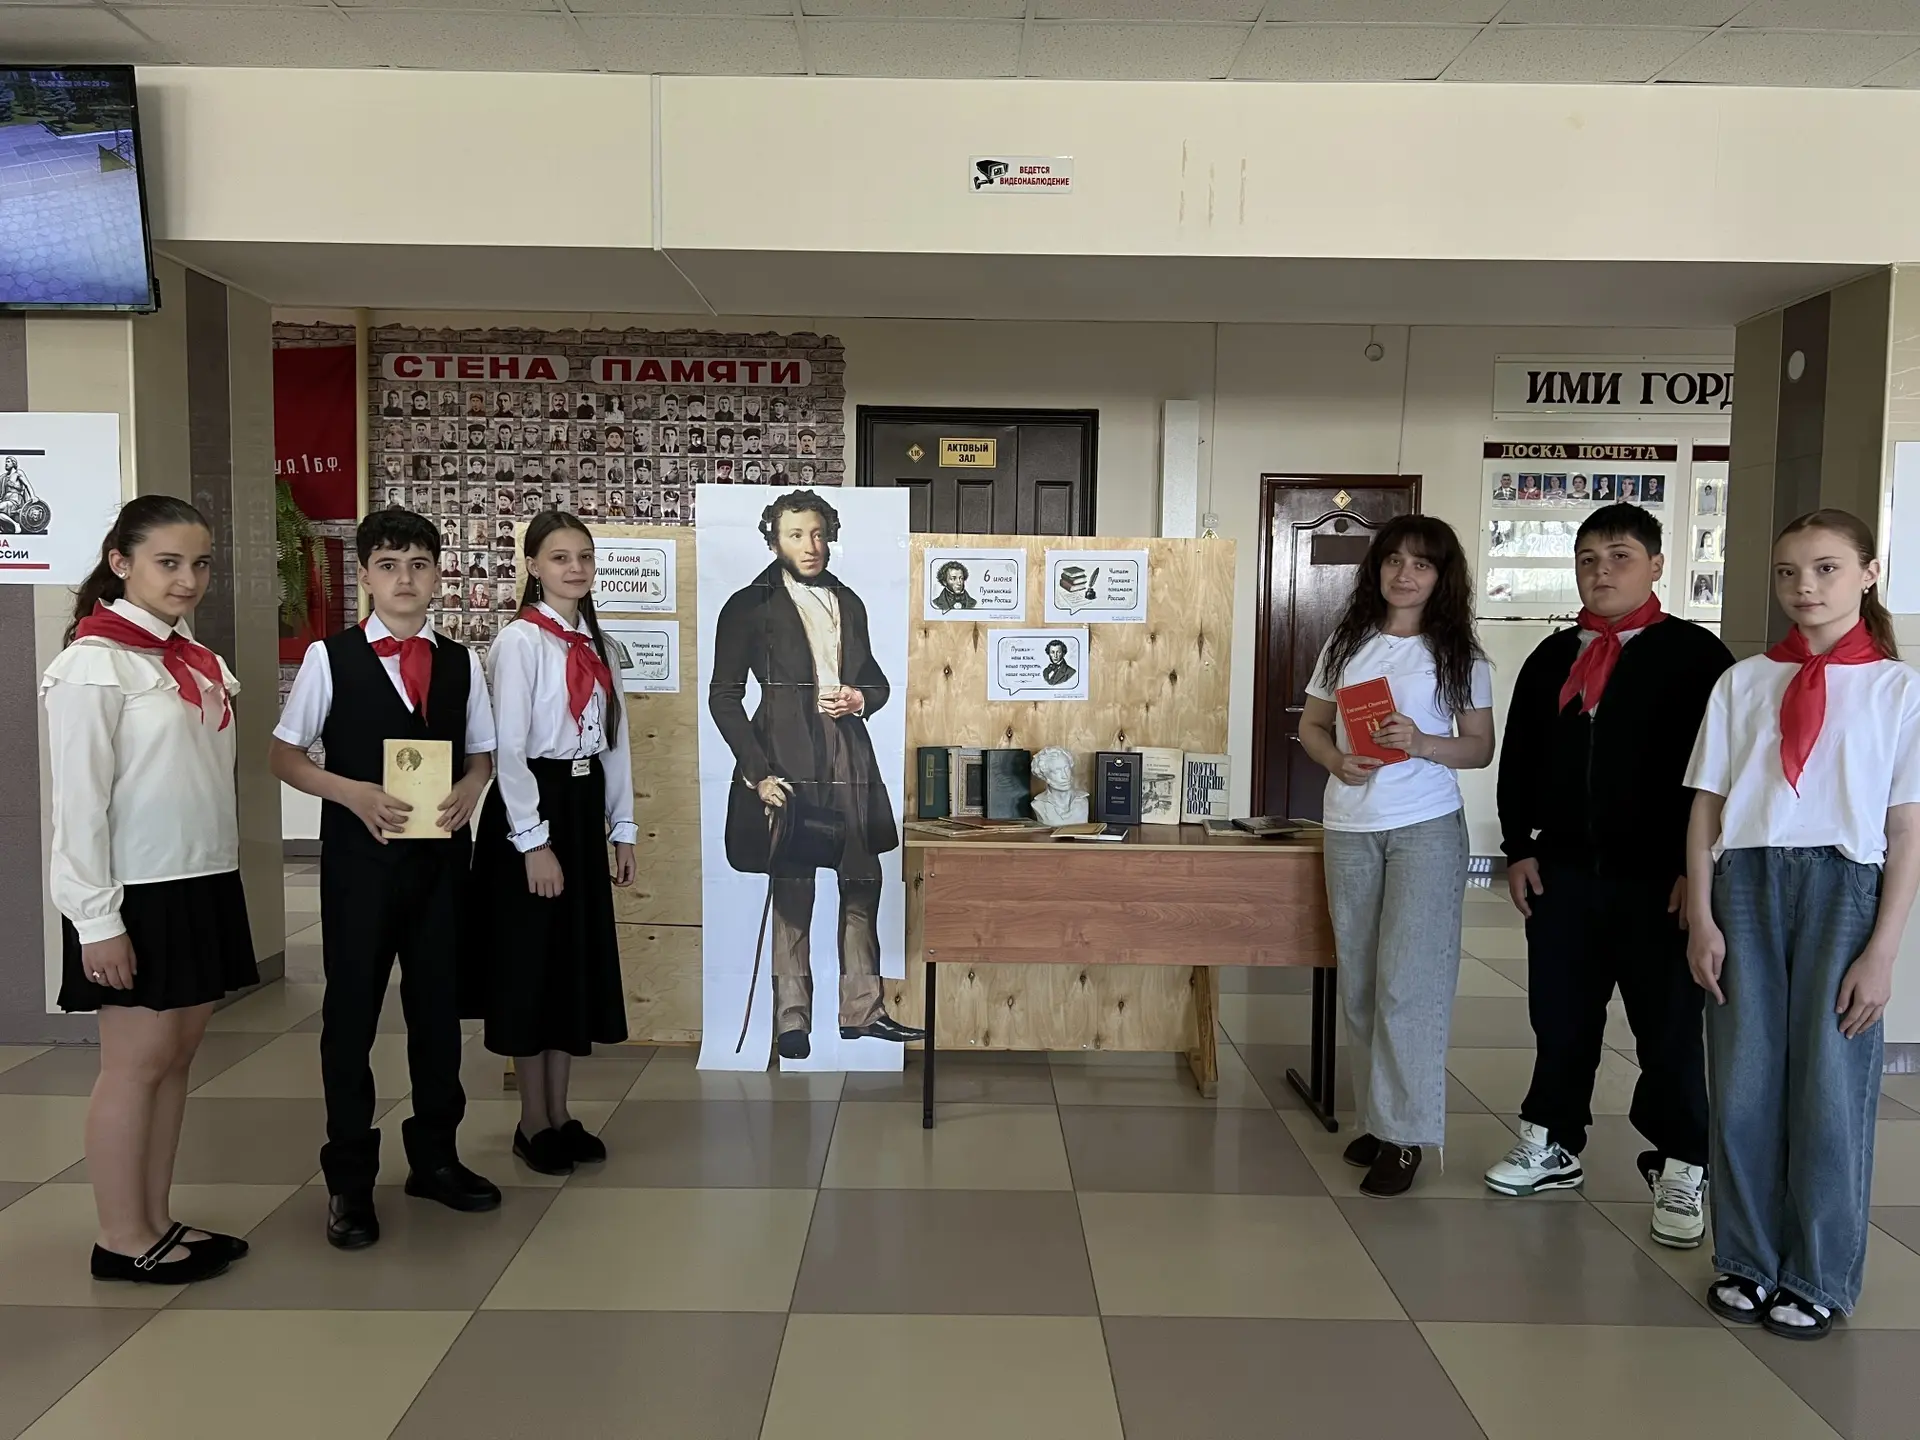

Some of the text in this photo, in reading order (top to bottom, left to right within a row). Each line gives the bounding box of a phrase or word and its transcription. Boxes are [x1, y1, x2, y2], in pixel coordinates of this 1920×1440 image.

[1019, 166, 1050, 174] ВЕДЕТСЯ
[999, 178, 1070, 186] ВИДЕОНАБЛЮДЕНИЕ
[393, 355, 800, 384] СТЕНА ПАМЯТИ
[1526, 371, 1623, 404] ИМИ
[947, 443, 989, 452] АКТОВЫЙ
[1501, 444, 1659, 460] ДОСКА ПОЧЕТА
[958, 454, 975, 462] ЗАЛ
[608, 552, 640, 563] 6 июня
[641, 568, 660, 578] ДЕНЬ
[983, 569, 991, 582] 6
[601, 580, 648, 592] РОССИИ
[979, 586, 1012, 595] Пушкинский
[981, 596, 1012, 605] день России
[631, 642, 650, 650] Открой
[1188, 761, 1217, 776] ПОЭТЫ
[1186, 800, 1211, 815] ПОРЫ
